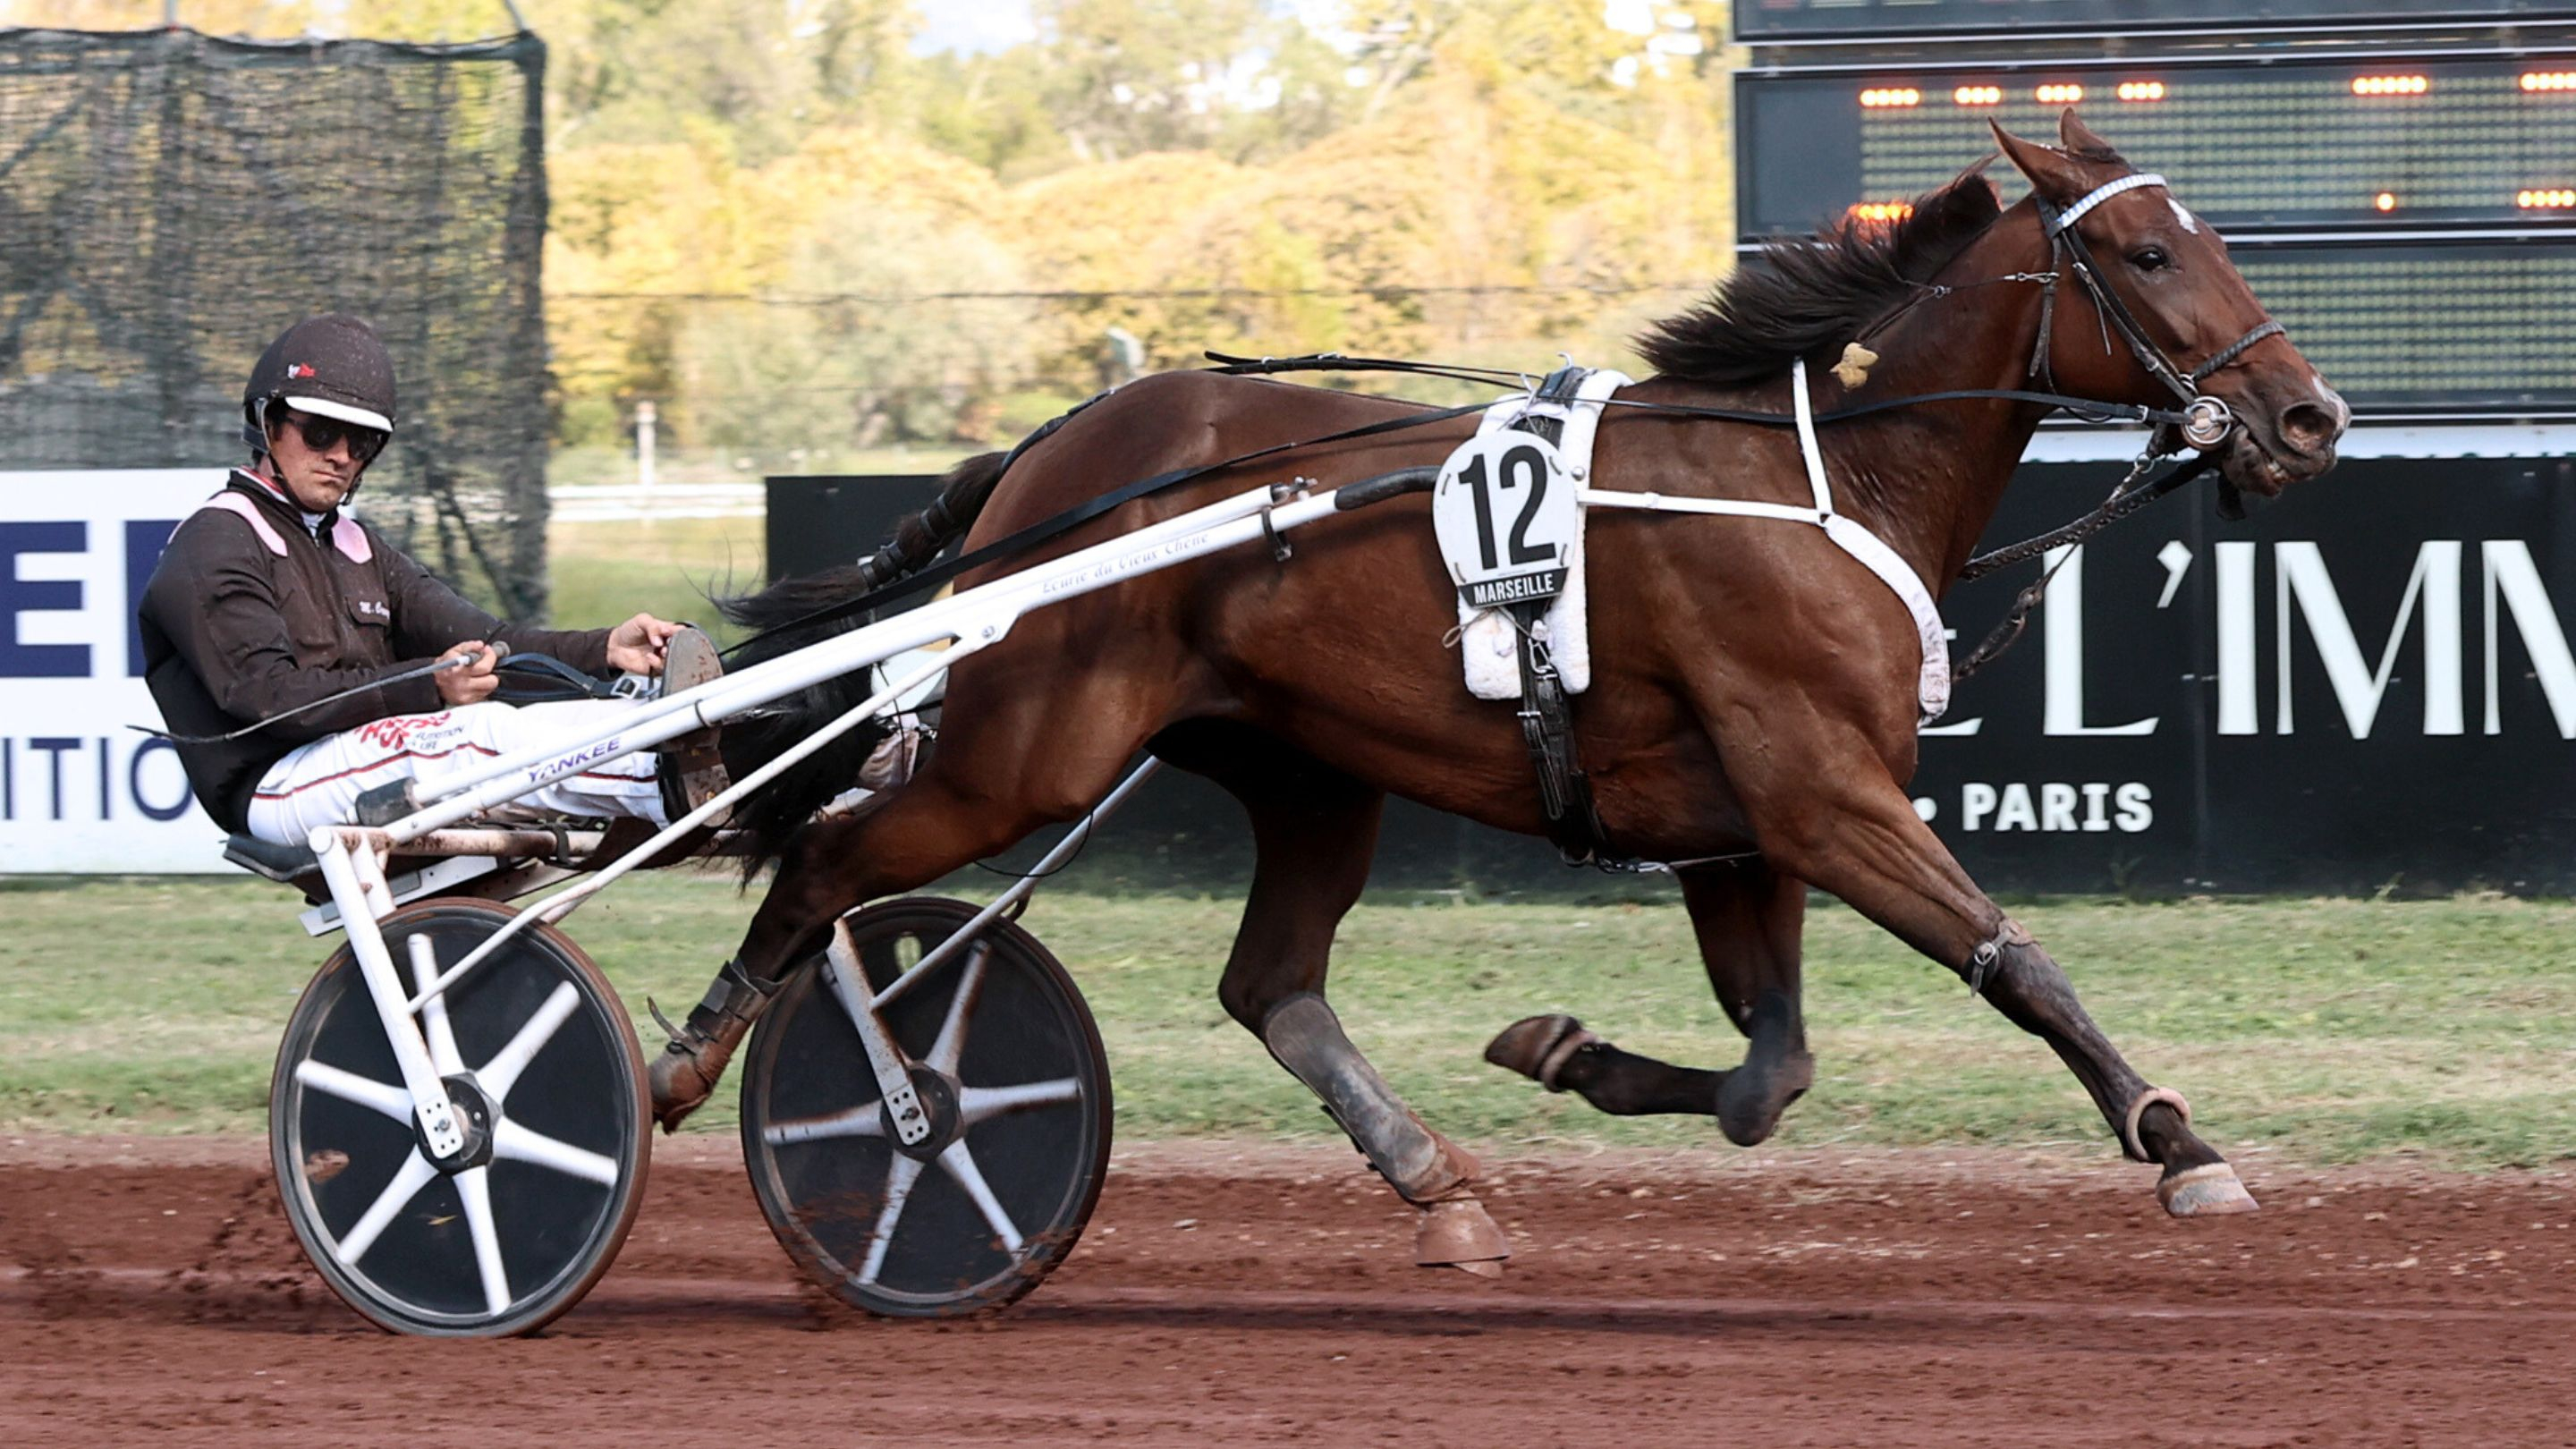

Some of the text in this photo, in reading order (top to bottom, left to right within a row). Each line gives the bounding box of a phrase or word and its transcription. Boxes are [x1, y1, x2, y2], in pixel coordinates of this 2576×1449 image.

[1458, 445, 1557, 571] 12
[1094, 562, 1113, 579] du
[1119, 552, 1158, 571] Vieux
[1474, 572, 1555, 605] MARSEILLE
[530, 737, 621, 783] YANKEE
[1962, 783, 2154, 832] PARIS
